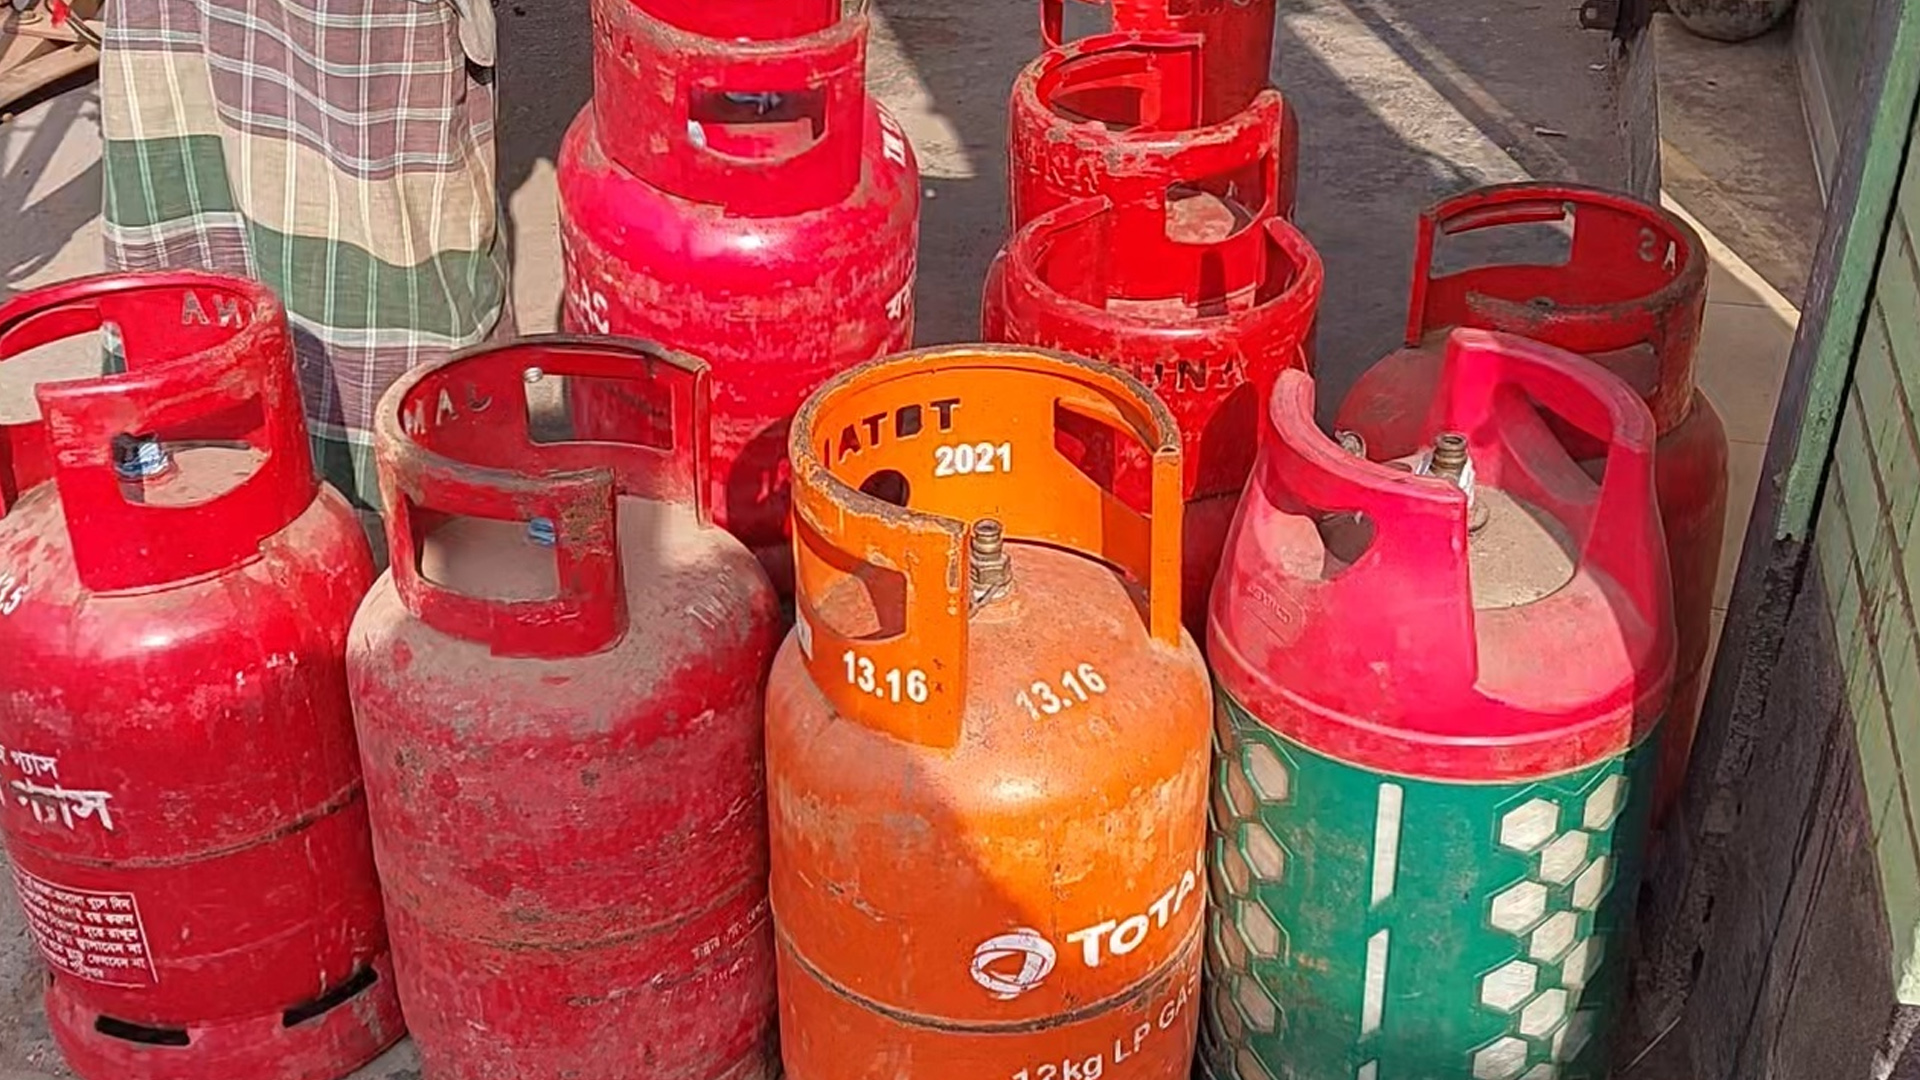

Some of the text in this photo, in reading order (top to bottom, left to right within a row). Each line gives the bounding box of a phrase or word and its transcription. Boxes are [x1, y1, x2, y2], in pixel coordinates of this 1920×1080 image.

[934, 441, 1012, 478] 2021
[842, 649, 930, 704] 13.16
[1015, 661, 1107, 723] 13.16
[1114, 1021, 1153, 1064] LP
